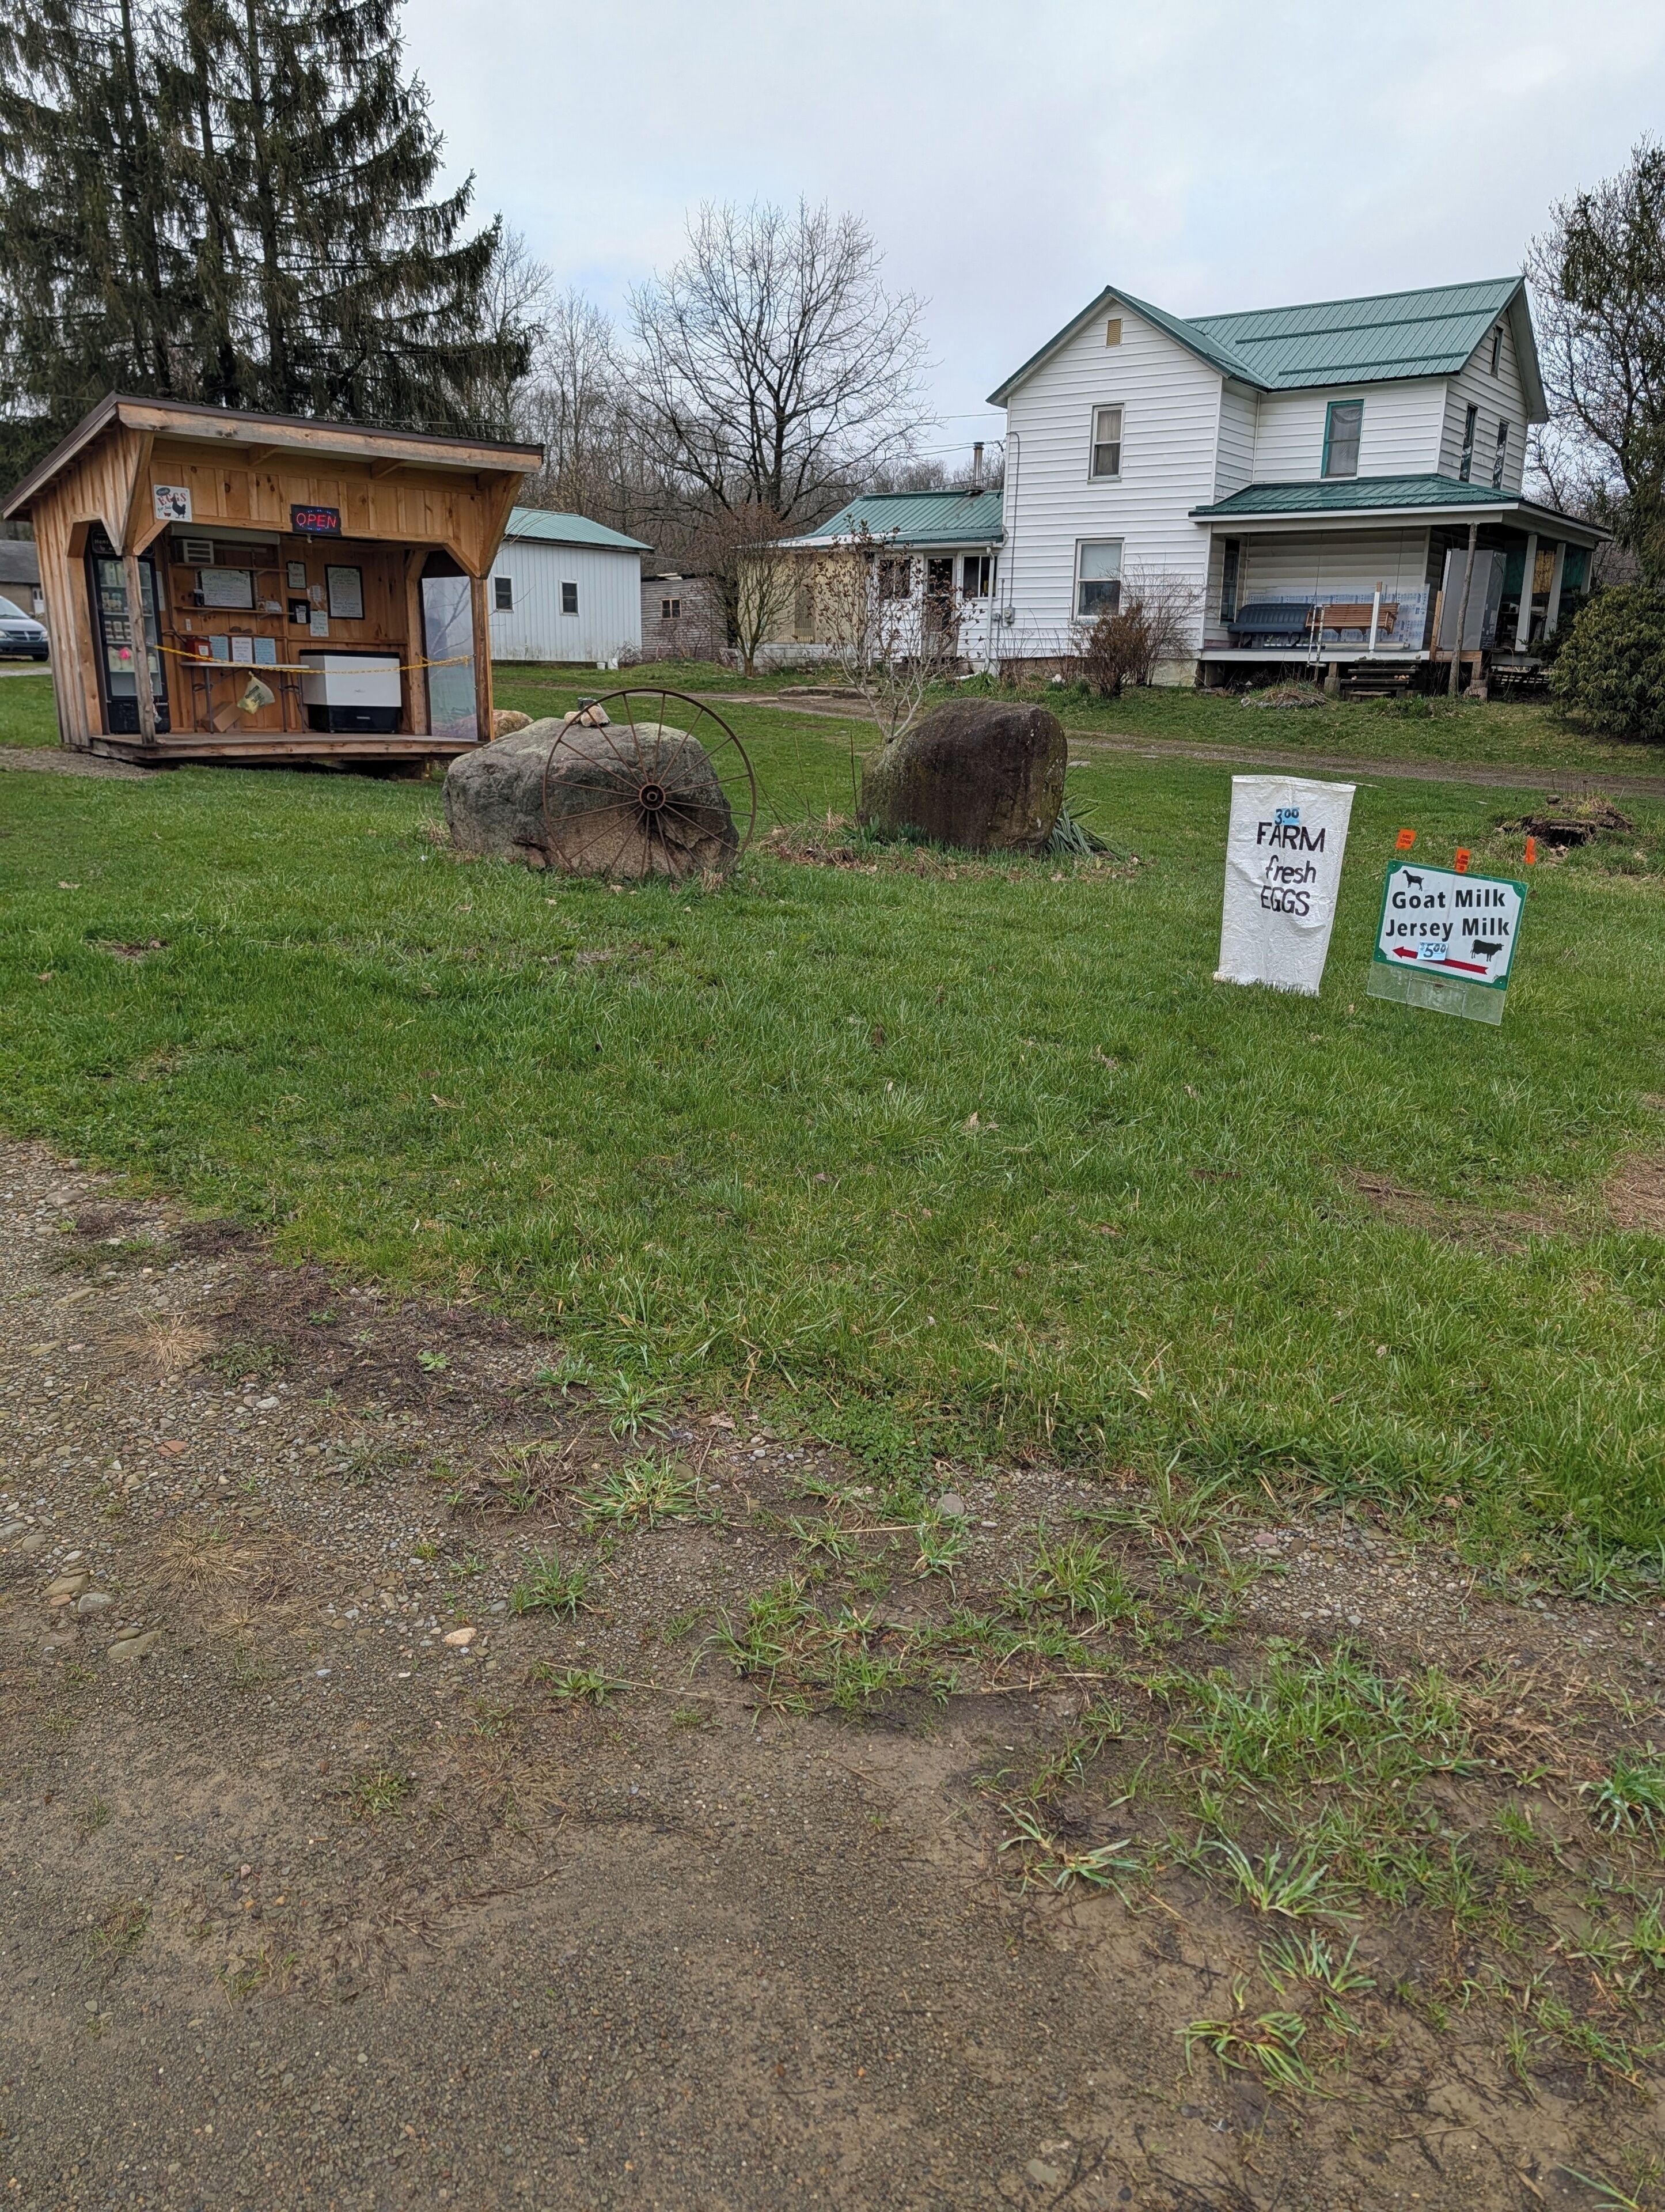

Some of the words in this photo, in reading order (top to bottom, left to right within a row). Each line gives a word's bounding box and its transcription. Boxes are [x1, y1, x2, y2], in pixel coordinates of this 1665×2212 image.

[157, 493, 187, 506] EGGS
[296, 513, 336, 528] OPEN
[1275, 808, 1299, 825] 3.00
[1257, 821, 1326, 853] FARM
[1265, 855, 1317, 884] fresh
[1261, 885, 1310, 916] EGGS
[1392, 891, 1446, 909] Goat
[1455, 889, 1505, 908] Milk
[1386, 919, 1454, 942] Jersey
[1462, 918, 1510, 935] Milk
